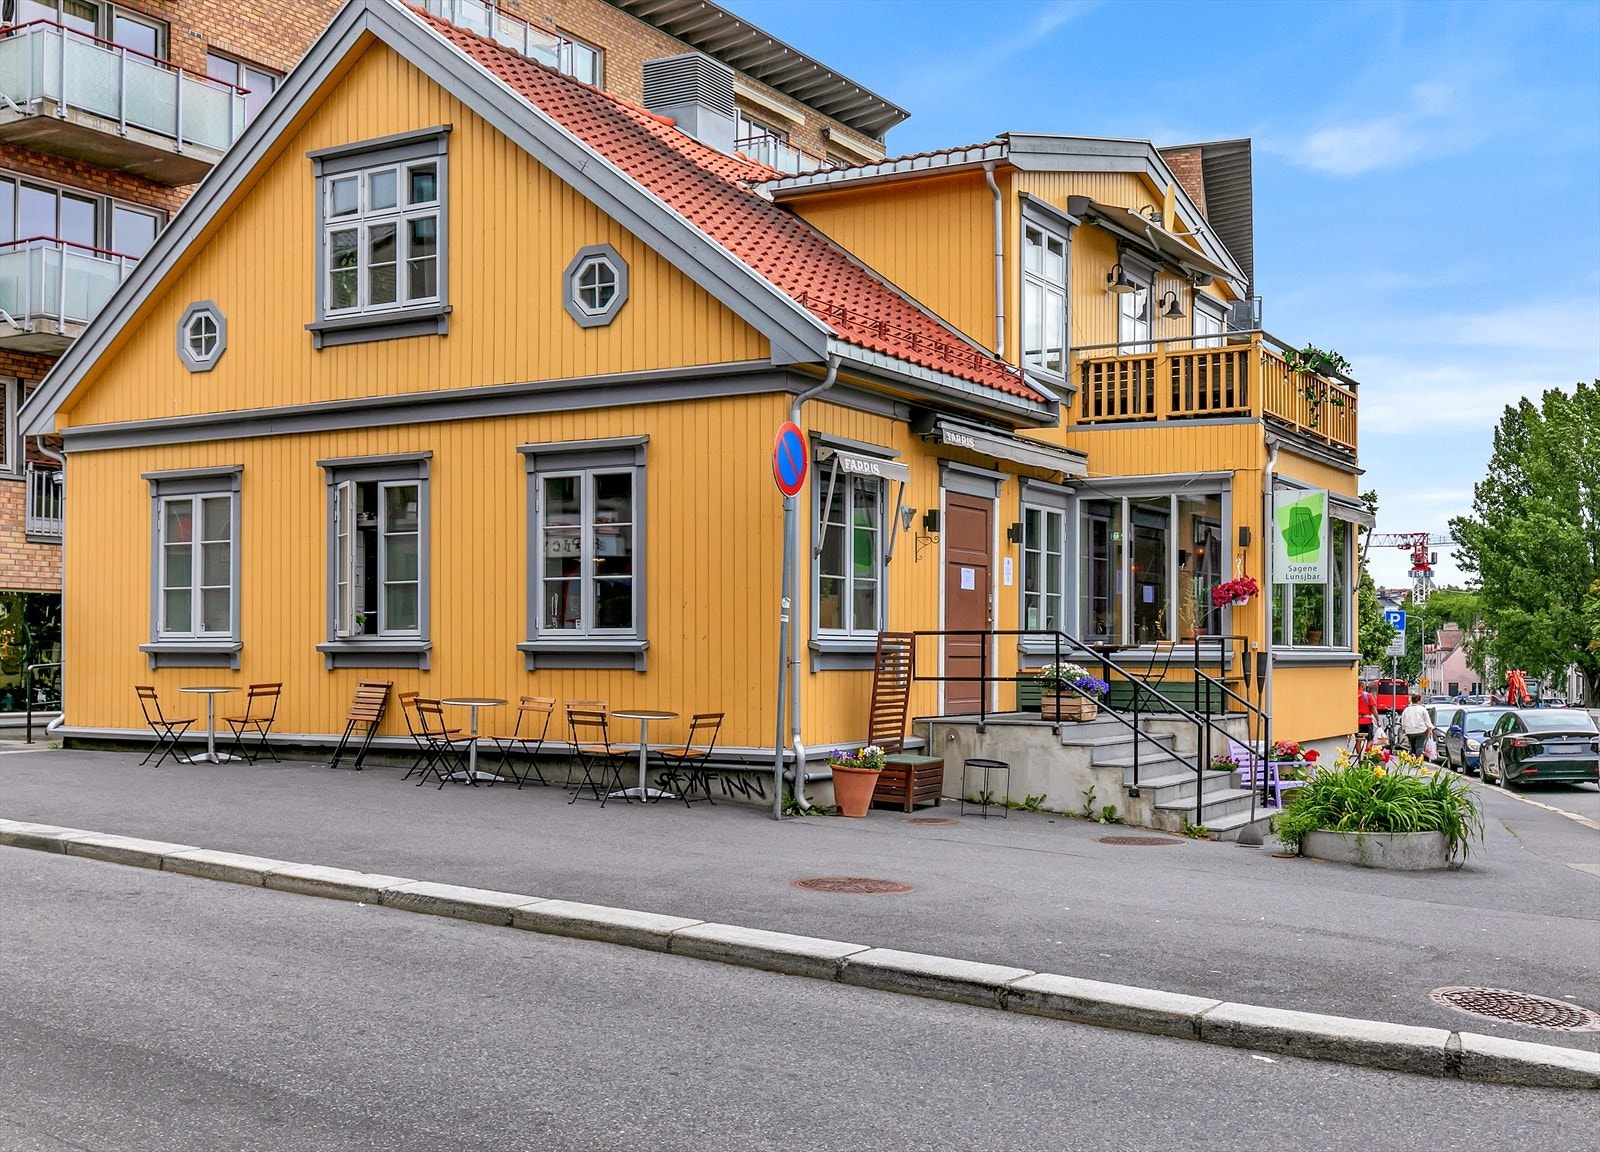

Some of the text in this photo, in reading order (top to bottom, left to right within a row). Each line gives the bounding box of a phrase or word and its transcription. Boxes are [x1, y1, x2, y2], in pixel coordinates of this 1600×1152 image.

[844, 458, 880, 475] FARRIS
[1288, 565, 1318, 573] Sagene
[1285, 573, 1320, 581] Lunsjbar
[1390, 613, 1401, 627] P
